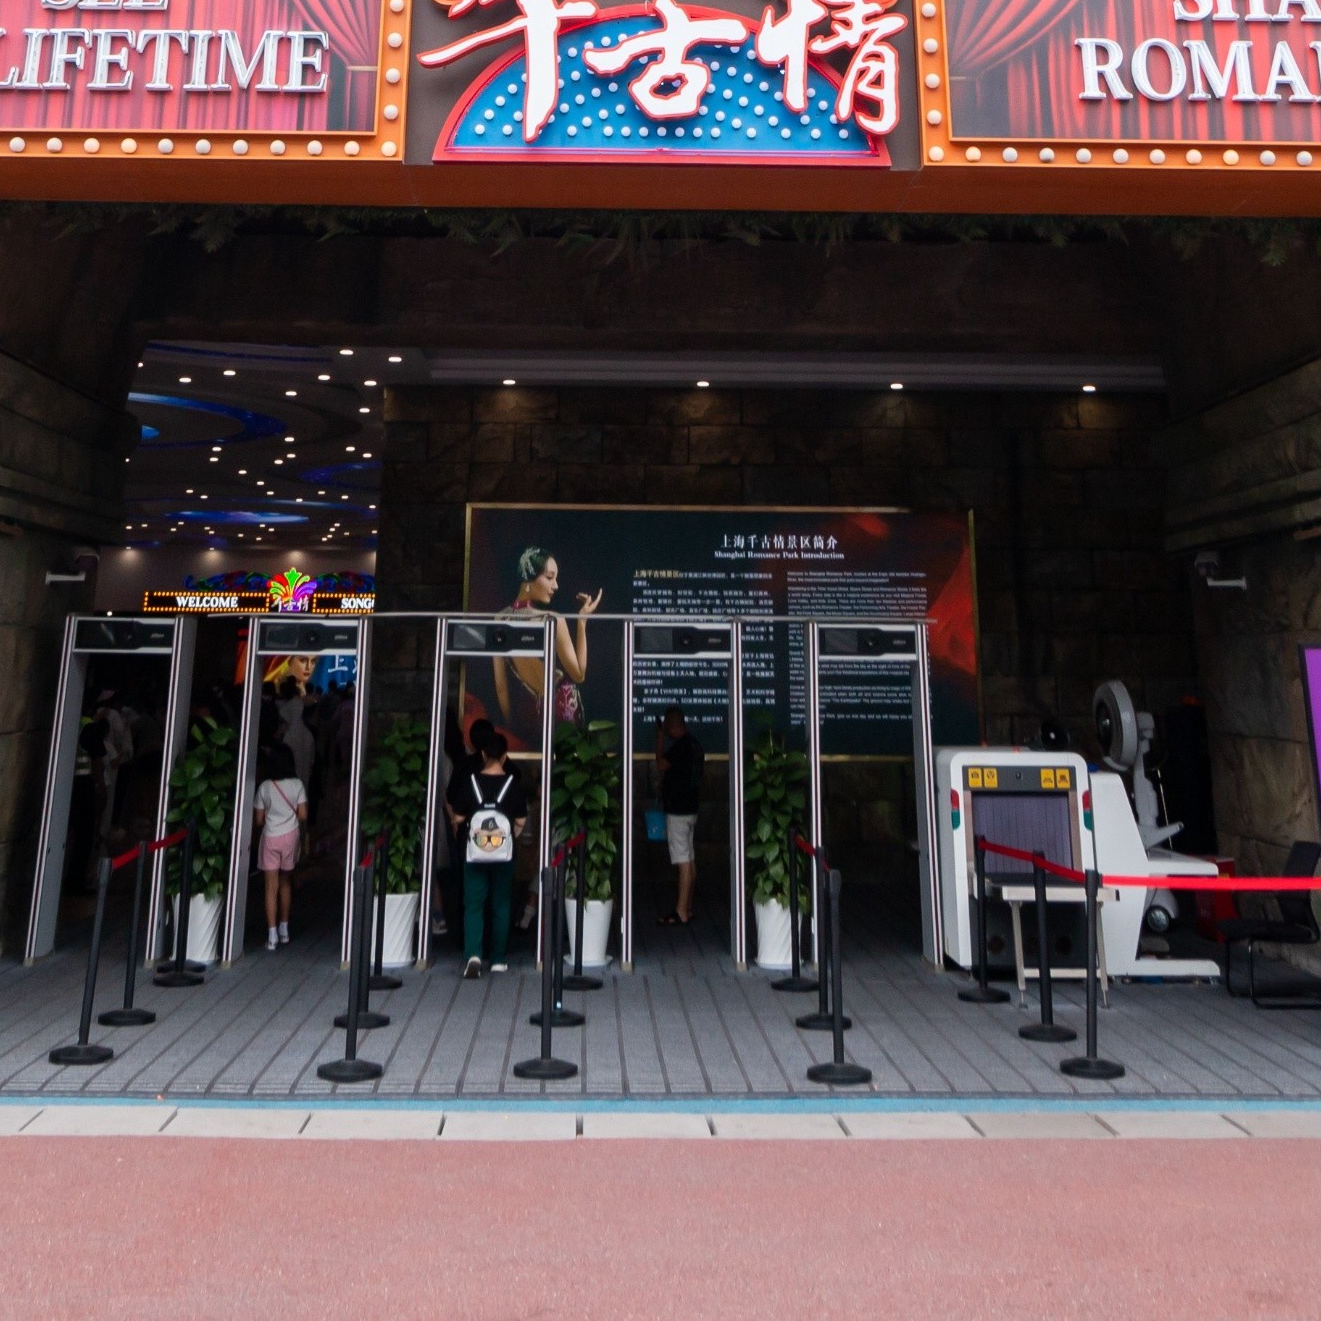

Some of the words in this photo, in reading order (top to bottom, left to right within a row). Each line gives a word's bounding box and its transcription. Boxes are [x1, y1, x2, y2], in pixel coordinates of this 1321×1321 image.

[720, 534, 838, 550] 上海千古情景区简介
[714, 551, 746, 560] Shanghai
[176, 596, 239, 608] WELCOME
